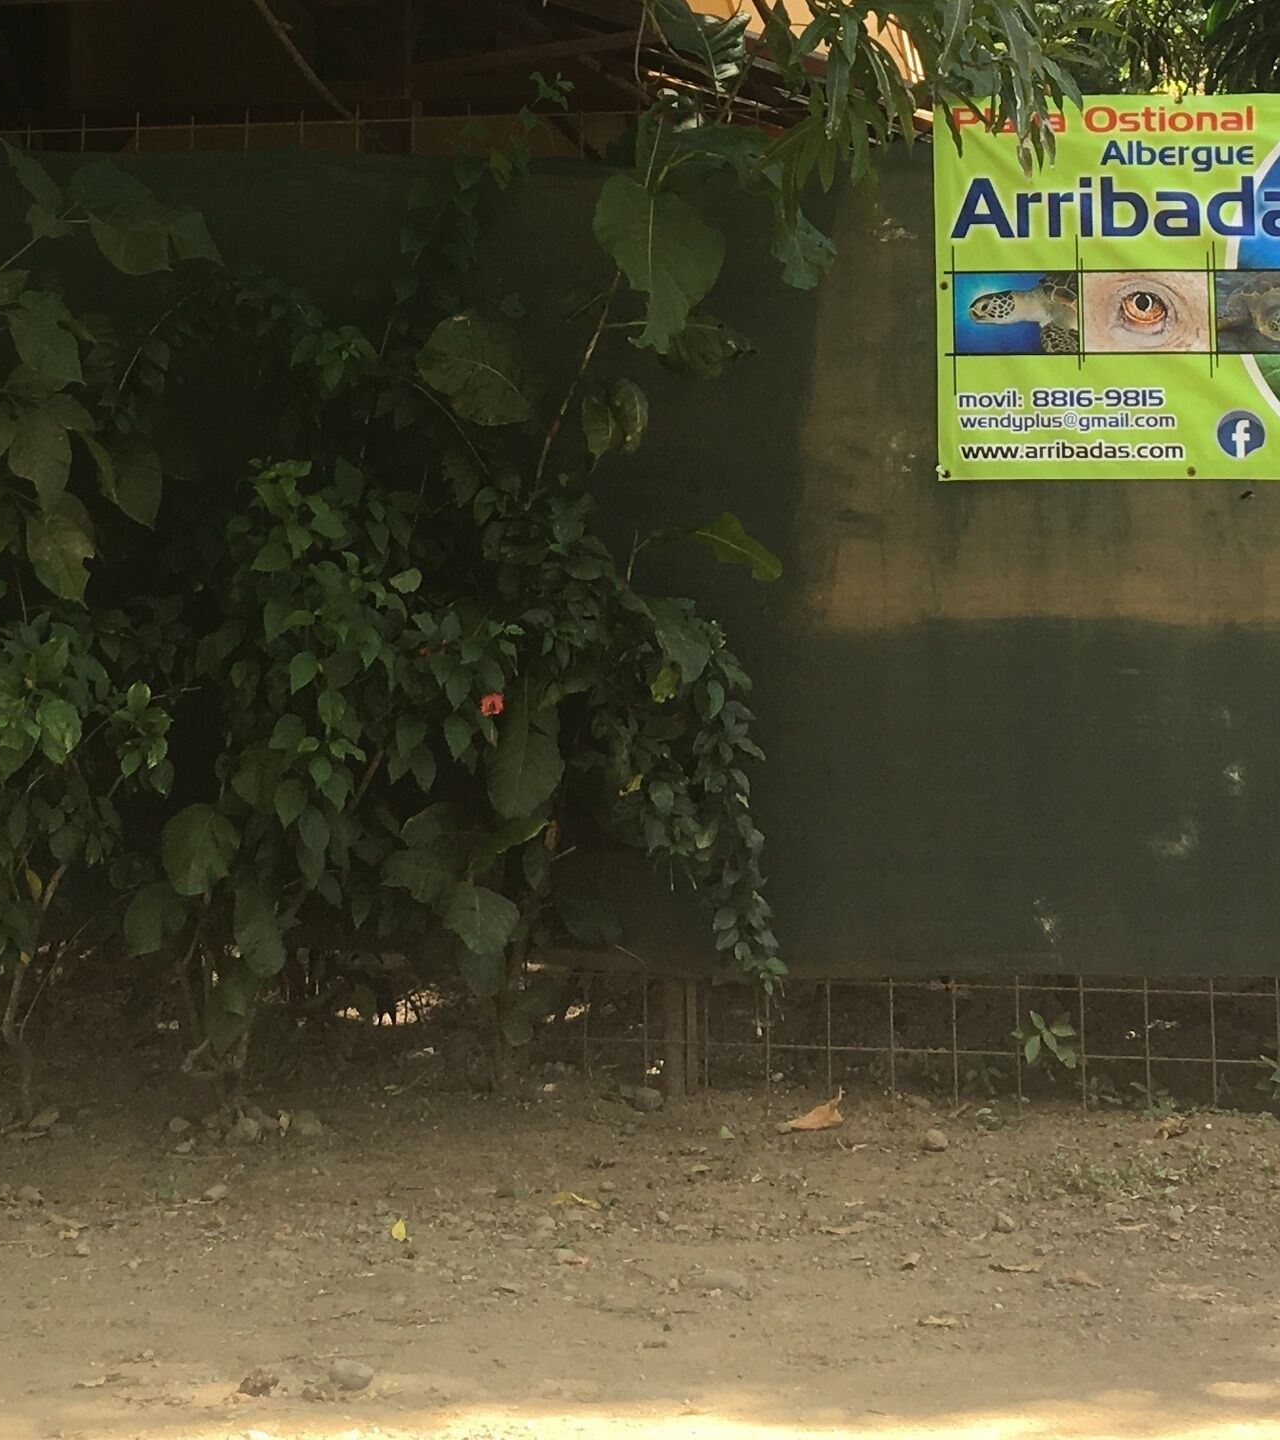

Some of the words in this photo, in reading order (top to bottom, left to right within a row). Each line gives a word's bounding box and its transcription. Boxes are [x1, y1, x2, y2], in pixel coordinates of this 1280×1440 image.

[1084, 105, 1254, 133] Ostional
[1100, 140, 1254, 172] Albergue
[959, 390, 1023, 408] movil:
[1032, 389, 1164, 408] 8816-9815
[960, 413, 1176, 432] wendyplus@gmail.com
[961, 441, 1184, 459] www.arribadas.com
